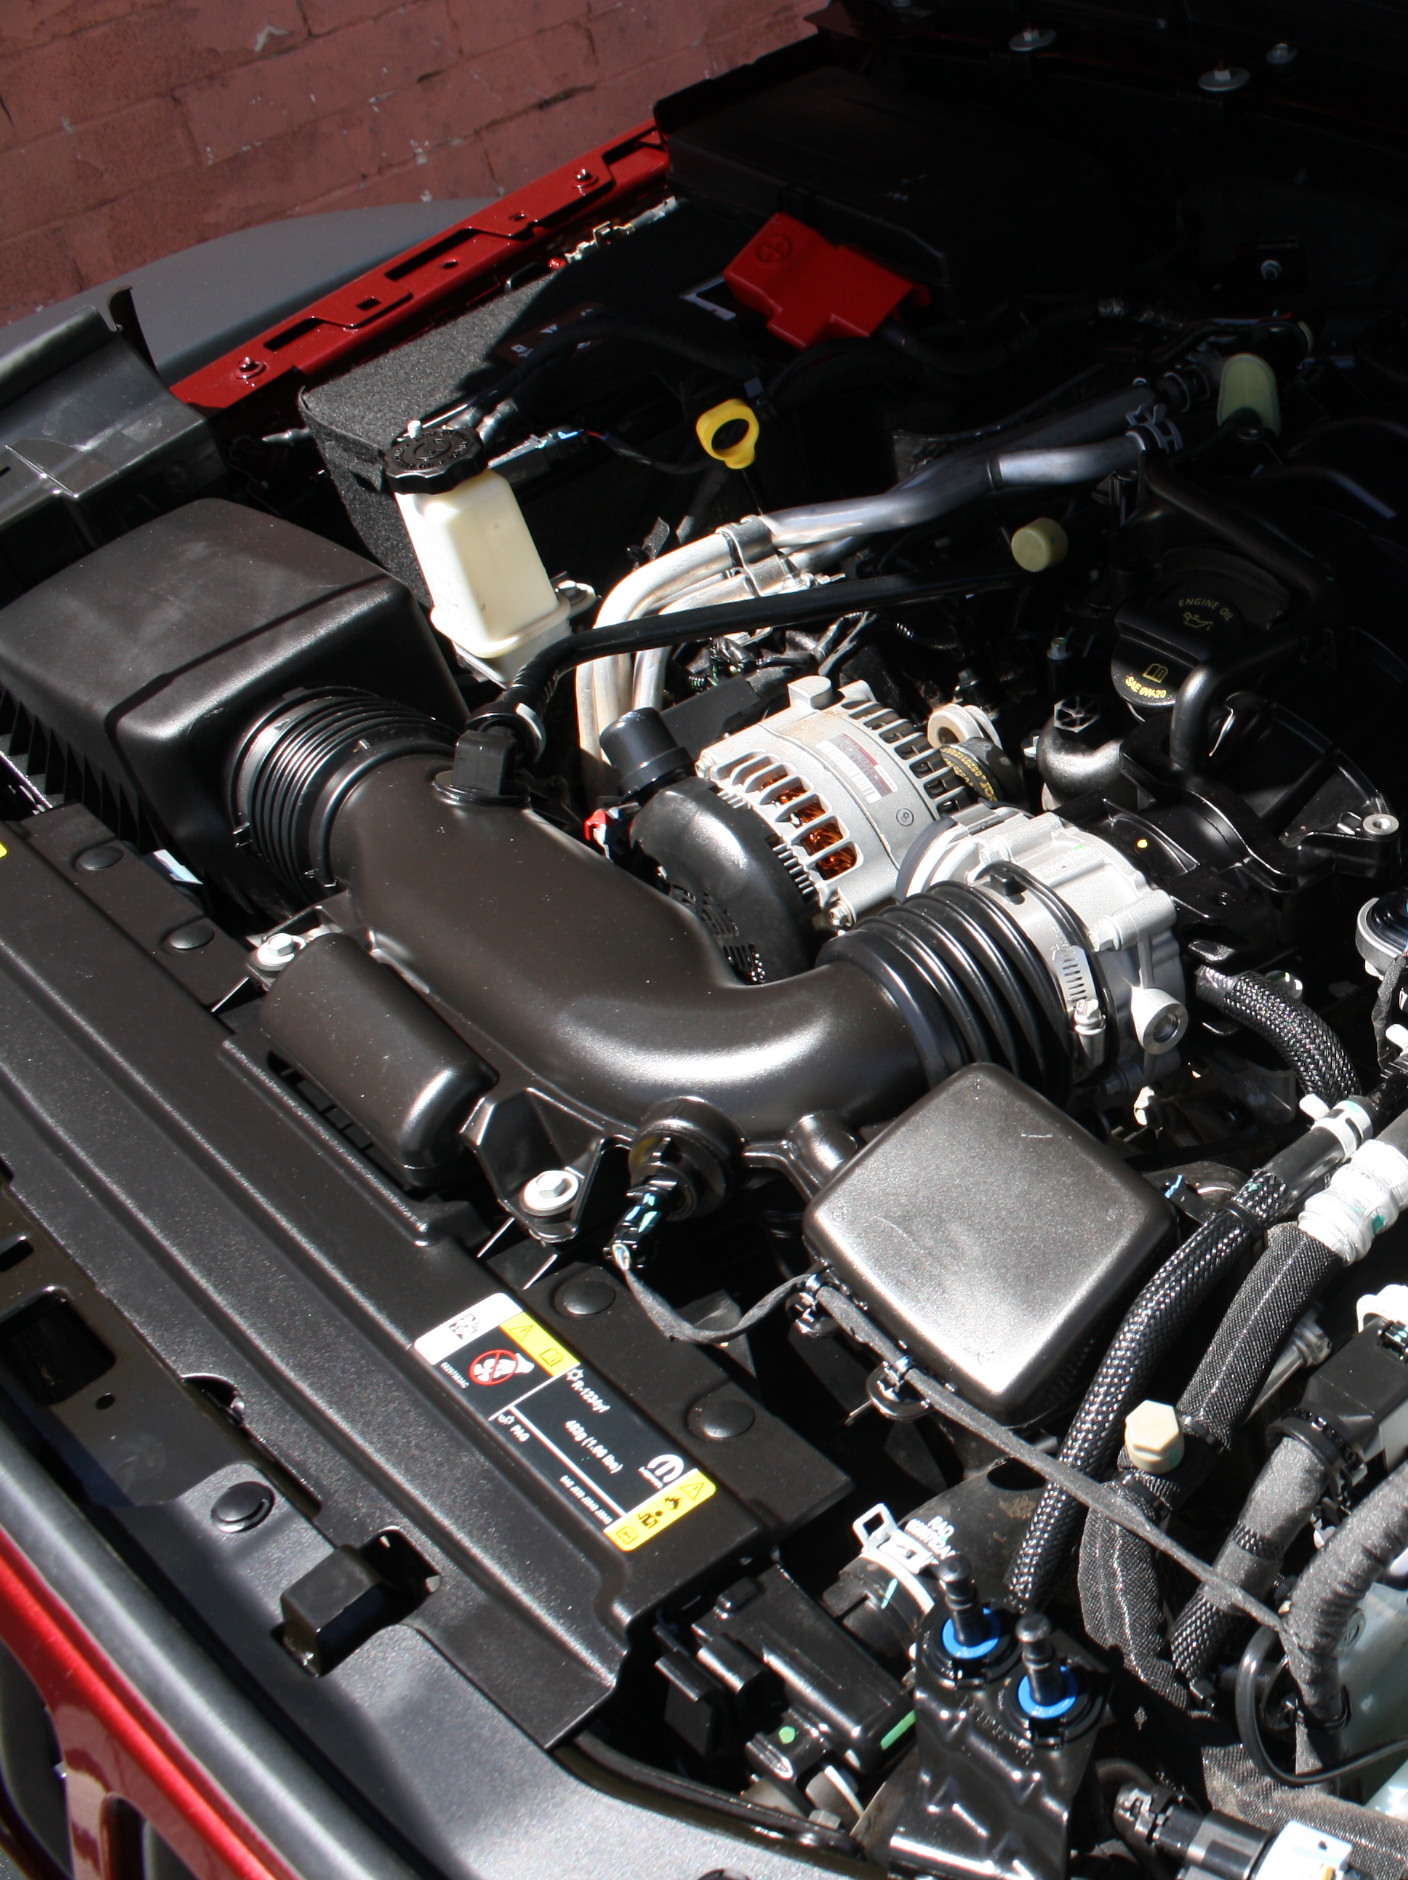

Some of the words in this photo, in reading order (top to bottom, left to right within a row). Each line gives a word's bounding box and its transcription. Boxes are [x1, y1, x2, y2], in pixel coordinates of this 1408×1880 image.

[1178, 598, 1220, 609] ENGINE
[1219, 608, 1235, 622] OIL
[1125, 676, 1142, 692] SAE
[1139, 688, 1166, 698] 0W-20
[570, 1379, 611, 1414] R-1234yf
[510, 1424, 531, 1443] PAG
[602, 1453, 624, 1475] lbs)
[927, 1515, 954, 1538] RAD
